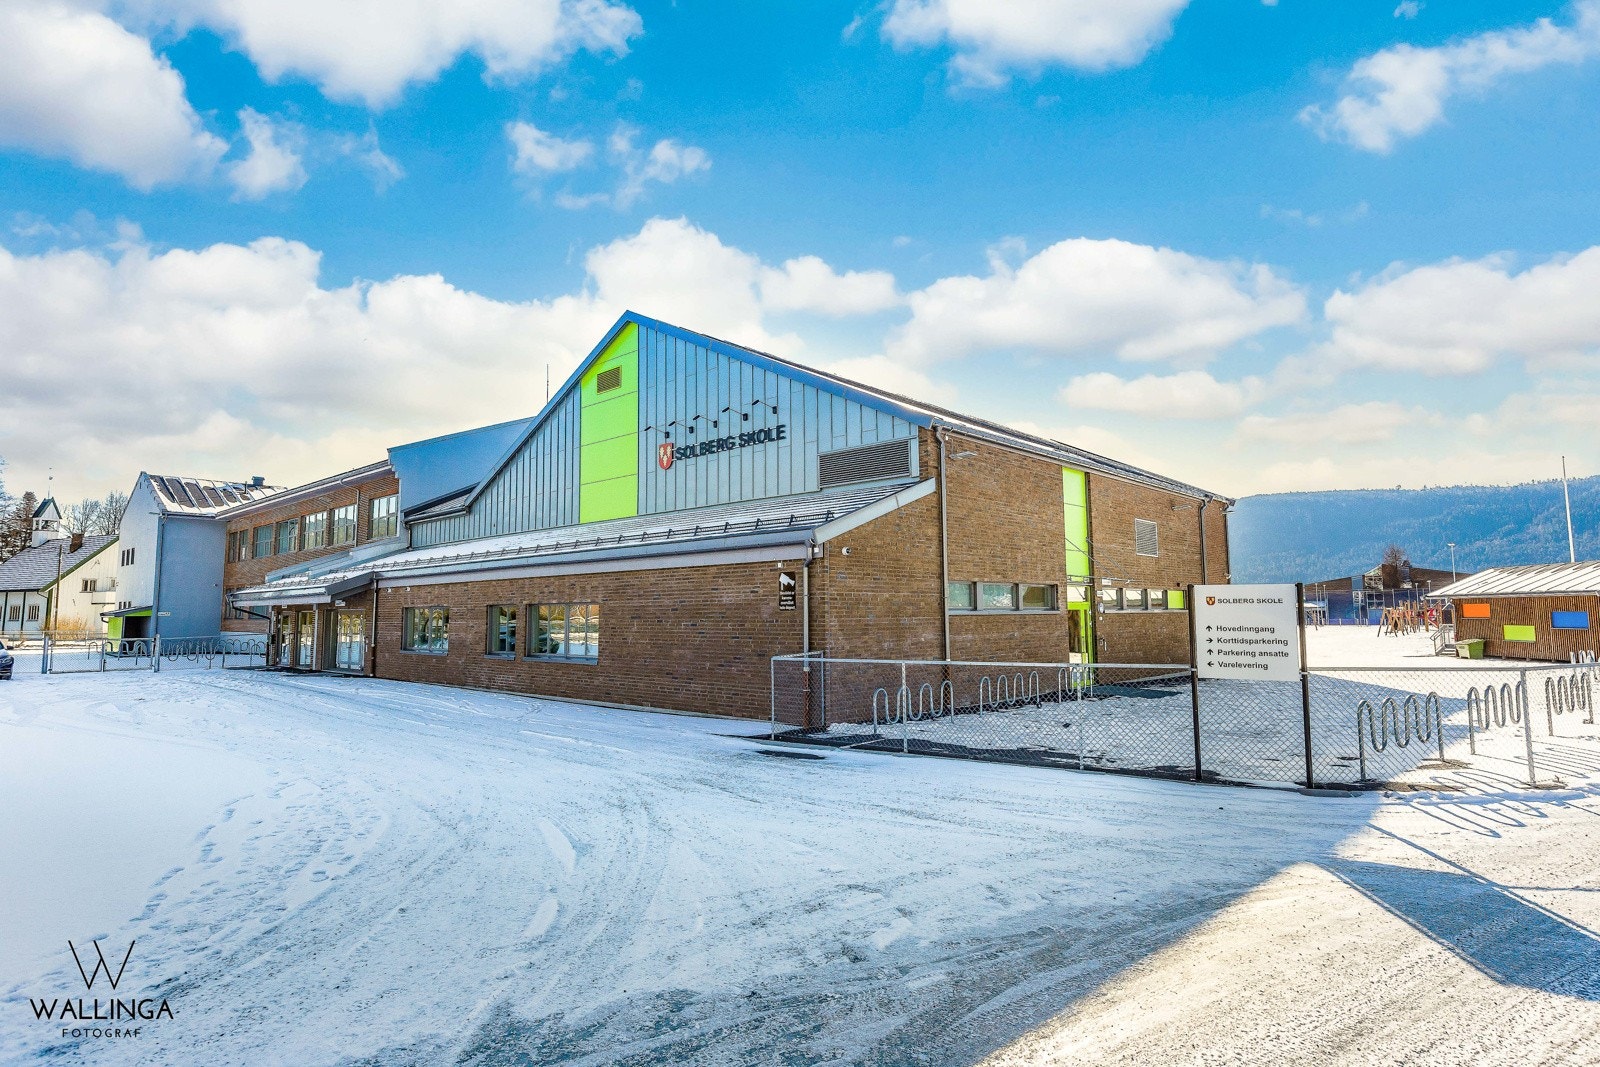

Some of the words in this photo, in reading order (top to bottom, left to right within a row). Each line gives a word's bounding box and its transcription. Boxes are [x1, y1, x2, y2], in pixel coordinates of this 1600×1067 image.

[675, 435, 736, 460] SOLBERG
[738, 424, 786, 448] SKOLE
[1216, 625, 1275, 634] Hovedinngang
[1216, 637, 1289, 646] Korttidsparkering
[1217, 649, 1256, 658] Parkering
[1217, 661, 1269, 670] Varelevering
